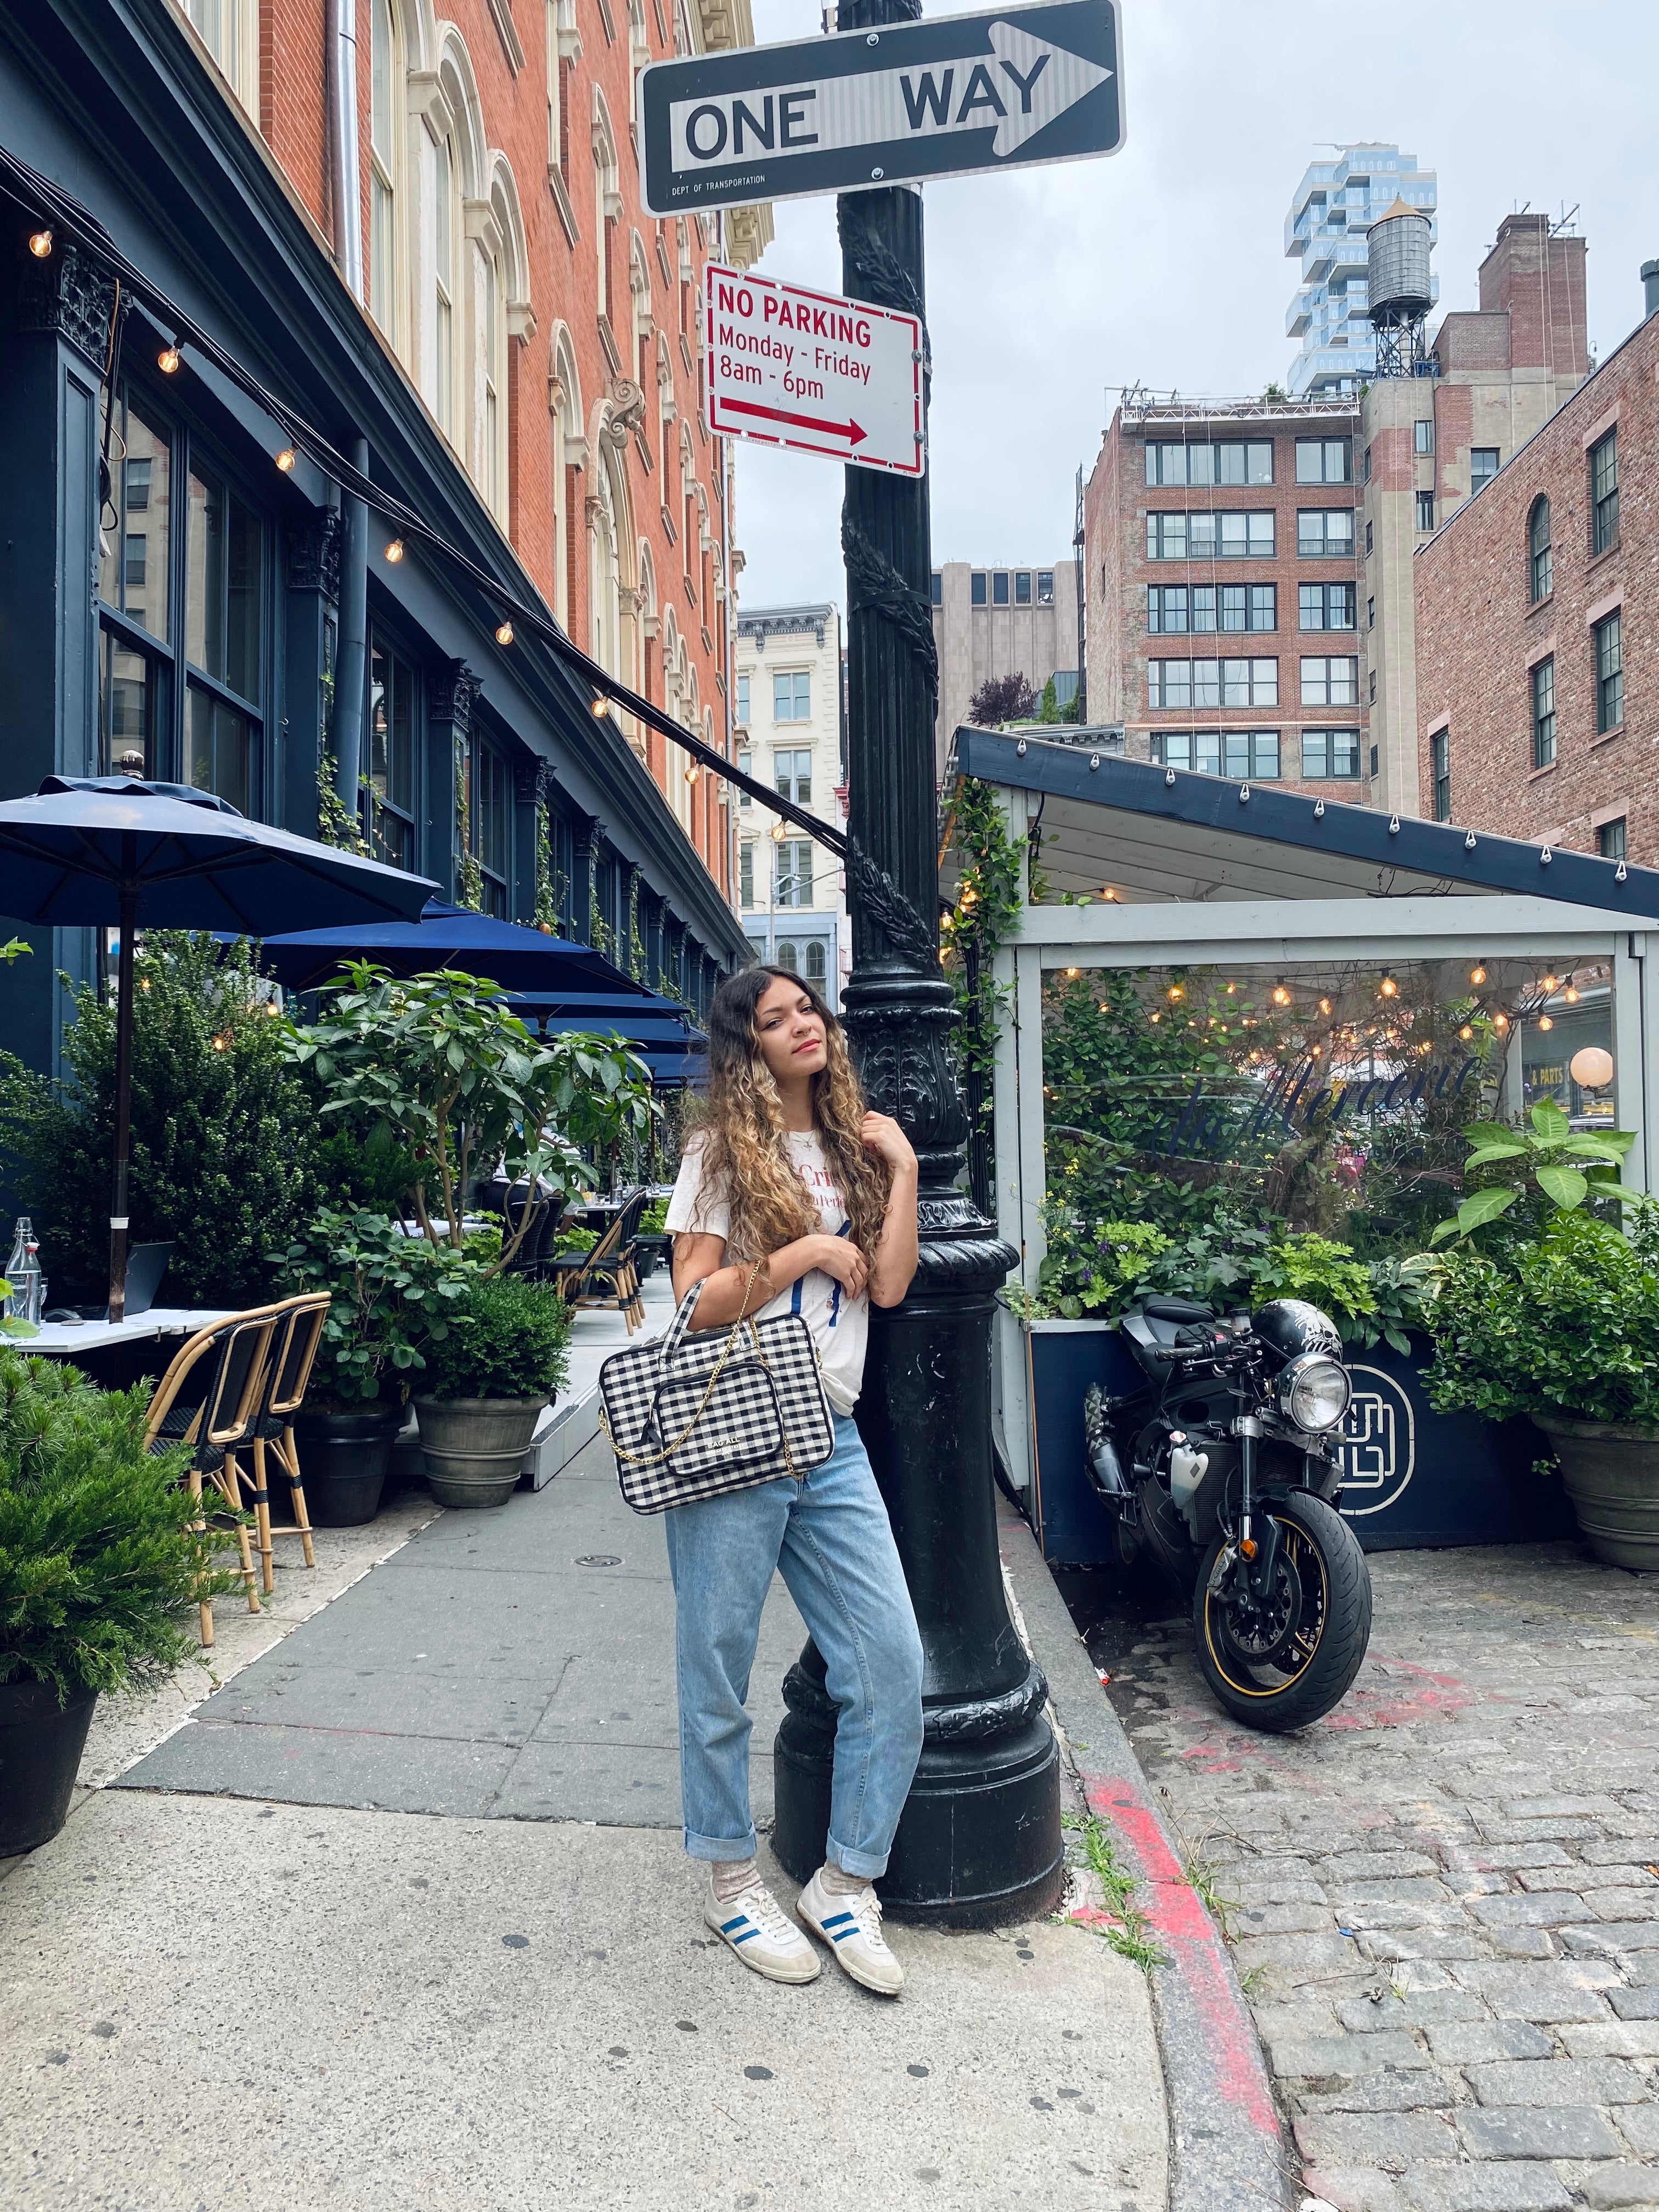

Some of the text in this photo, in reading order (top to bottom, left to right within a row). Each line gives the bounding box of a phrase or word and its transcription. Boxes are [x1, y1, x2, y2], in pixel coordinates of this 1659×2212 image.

[686, 54, 1051, 160] ONE WAY
[672, 174, 765, 196] DEPT OF TRANSPORTATION
[719, 283, 871, 348] NO PARKING
[719, 323, 794, 367] Monday
[815, 347, 871, 386] Friday
[720, 354, 762, 385] 8am
[783, 370, 823, 400] 6pm
[1540, 1066, 1564, 1085] PARTS
[707, 1440, 724, 1449] BAG
